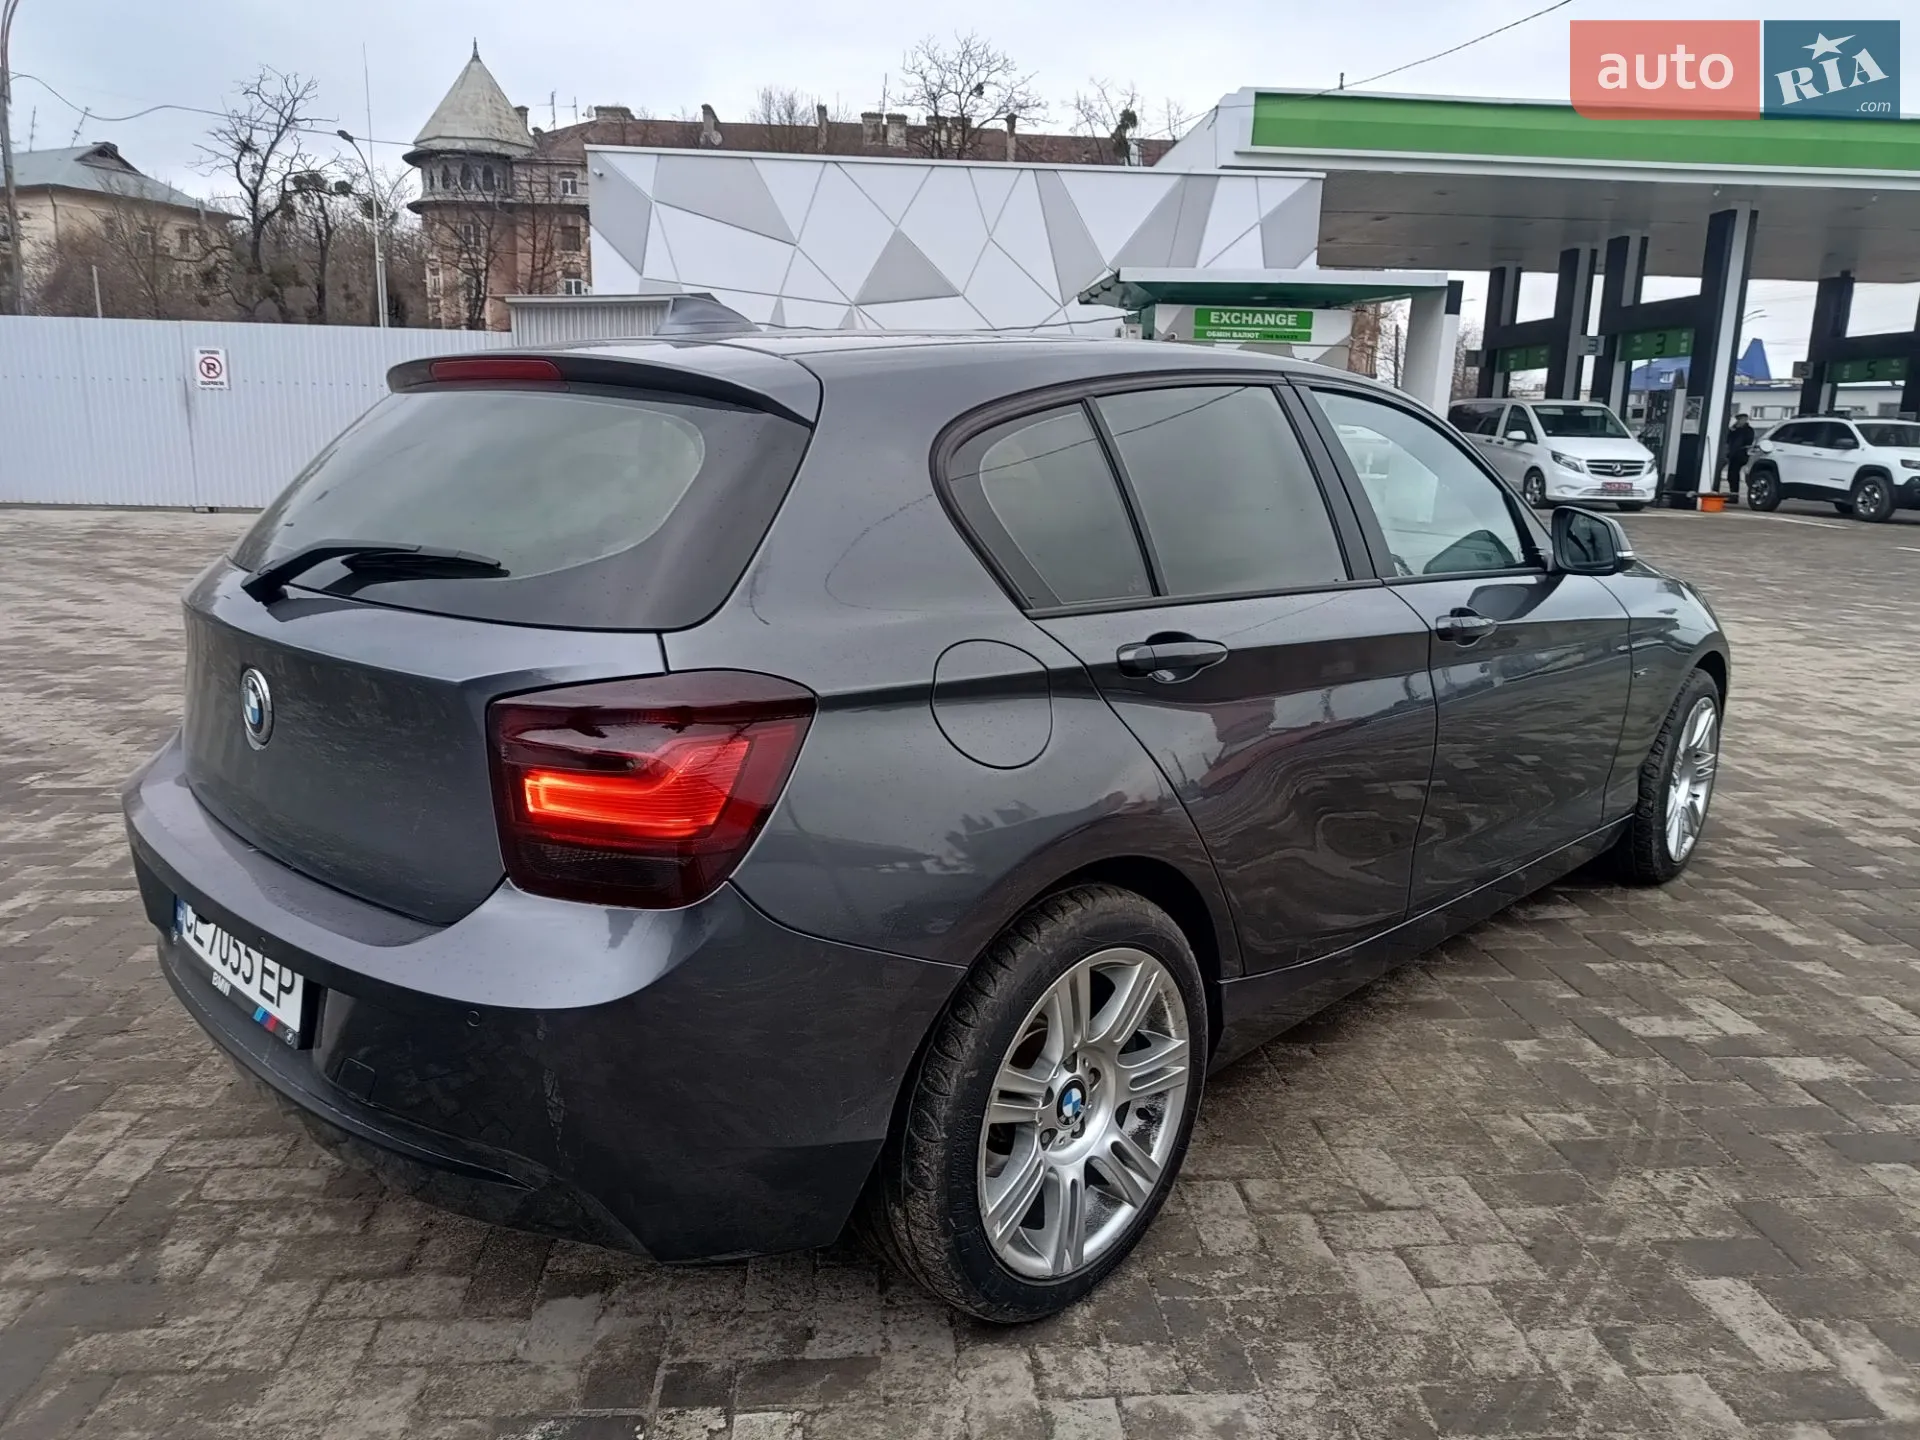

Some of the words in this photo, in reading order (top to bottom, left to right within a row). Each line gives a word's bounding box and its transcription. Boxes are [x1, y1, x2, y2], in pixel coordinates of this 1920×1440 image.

[1210, 311, 1298, 326] EXCHANGE
[1588, 339, 1599, 353] 3
[1655, 333, 1667, 355] 3
[1866, 361, 1878, 378] 5
[259, 956, 296, 1009] EP
